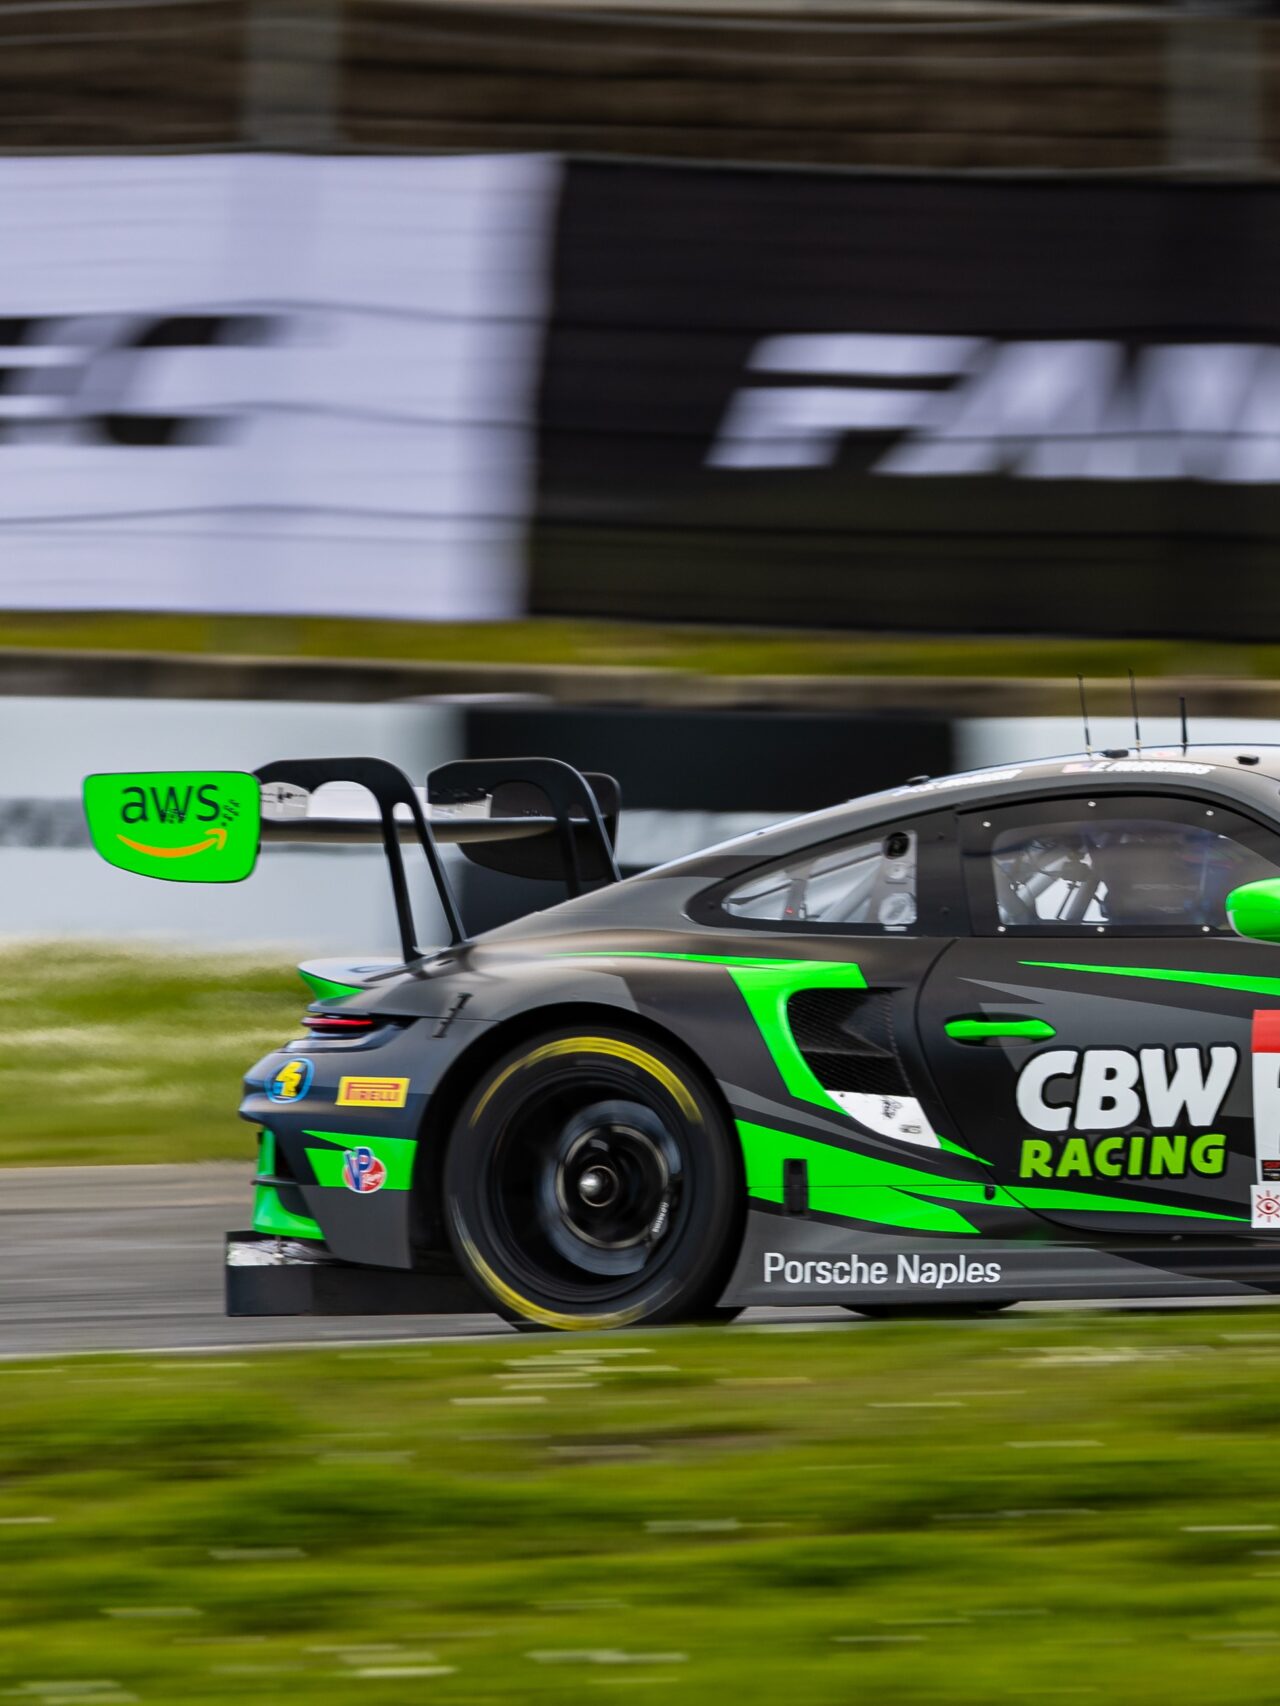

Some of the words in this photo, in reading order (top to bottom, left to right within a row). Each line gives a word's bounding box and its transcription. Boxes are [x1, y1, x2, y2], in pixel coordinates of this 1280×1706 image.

[121, 784, 220, 824] aws
[1016, 1046, 1237, 1131] CBW
[1019, 1134, 1227, 1178] RACING
[764, 1252, 888, 1284] Porsche
[896, 1254, 1001, 1288] Naples
